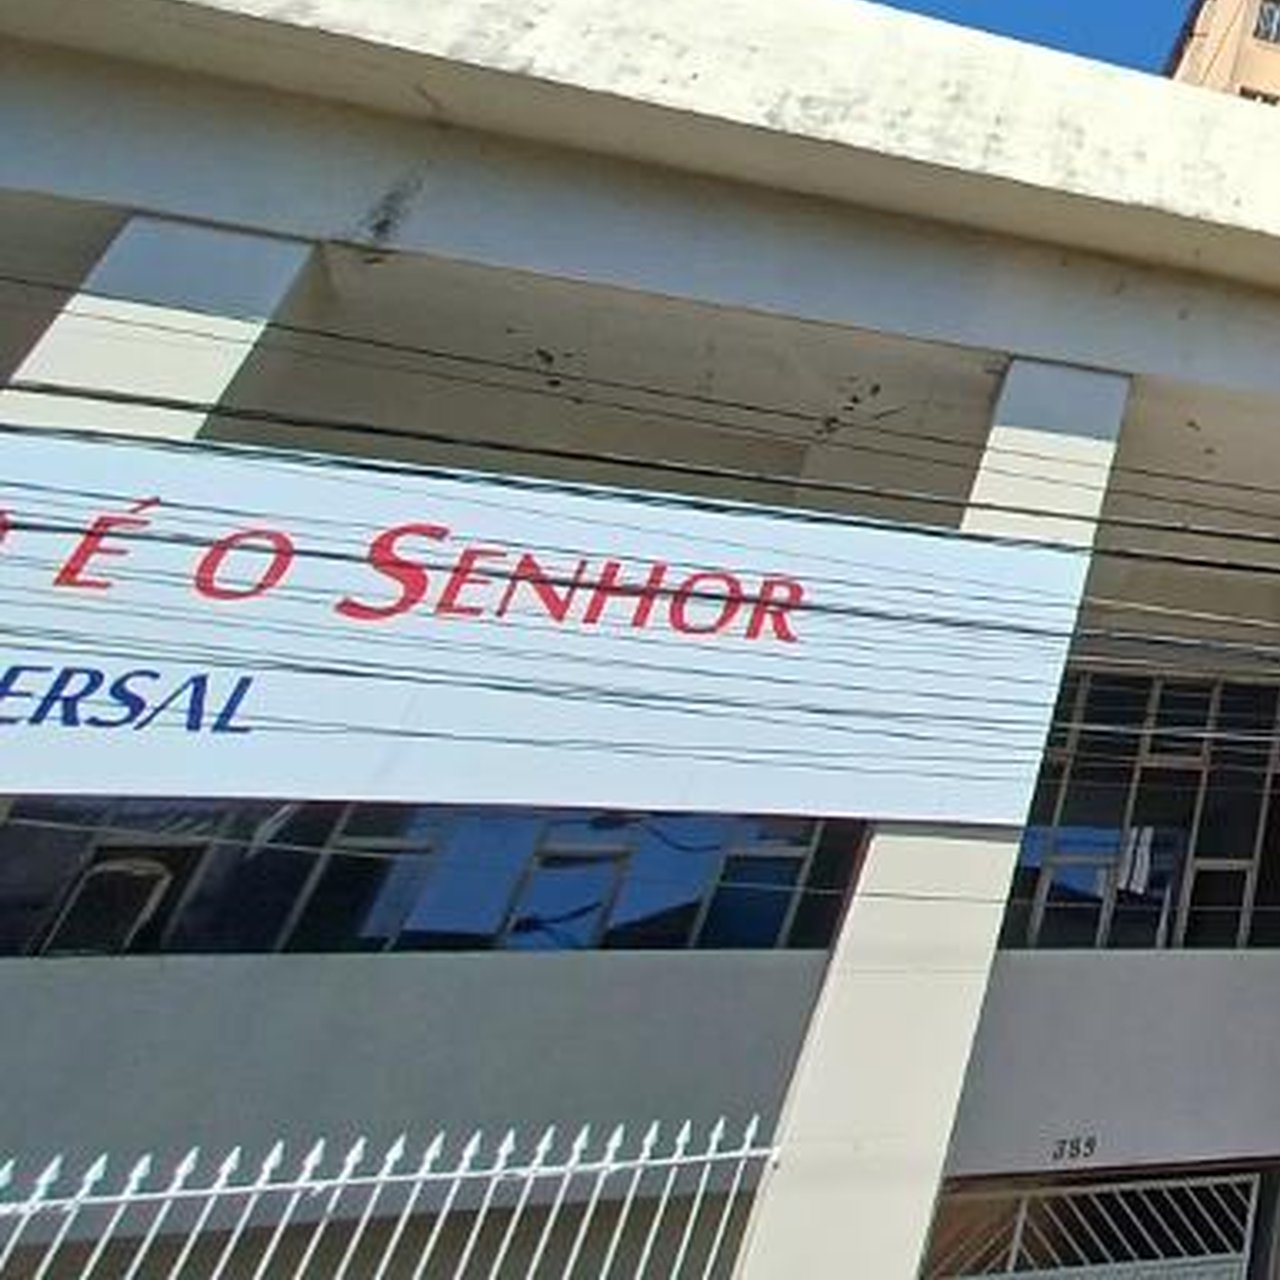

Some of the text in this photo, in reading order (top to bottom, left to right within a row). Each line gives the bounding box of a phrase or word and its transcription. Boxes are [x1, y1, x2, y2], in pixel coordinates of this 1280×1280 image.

[53, 496, 161, 589] É
[193, 529, 294, 600] O
[334, 523, 805, 643] SENHOR
